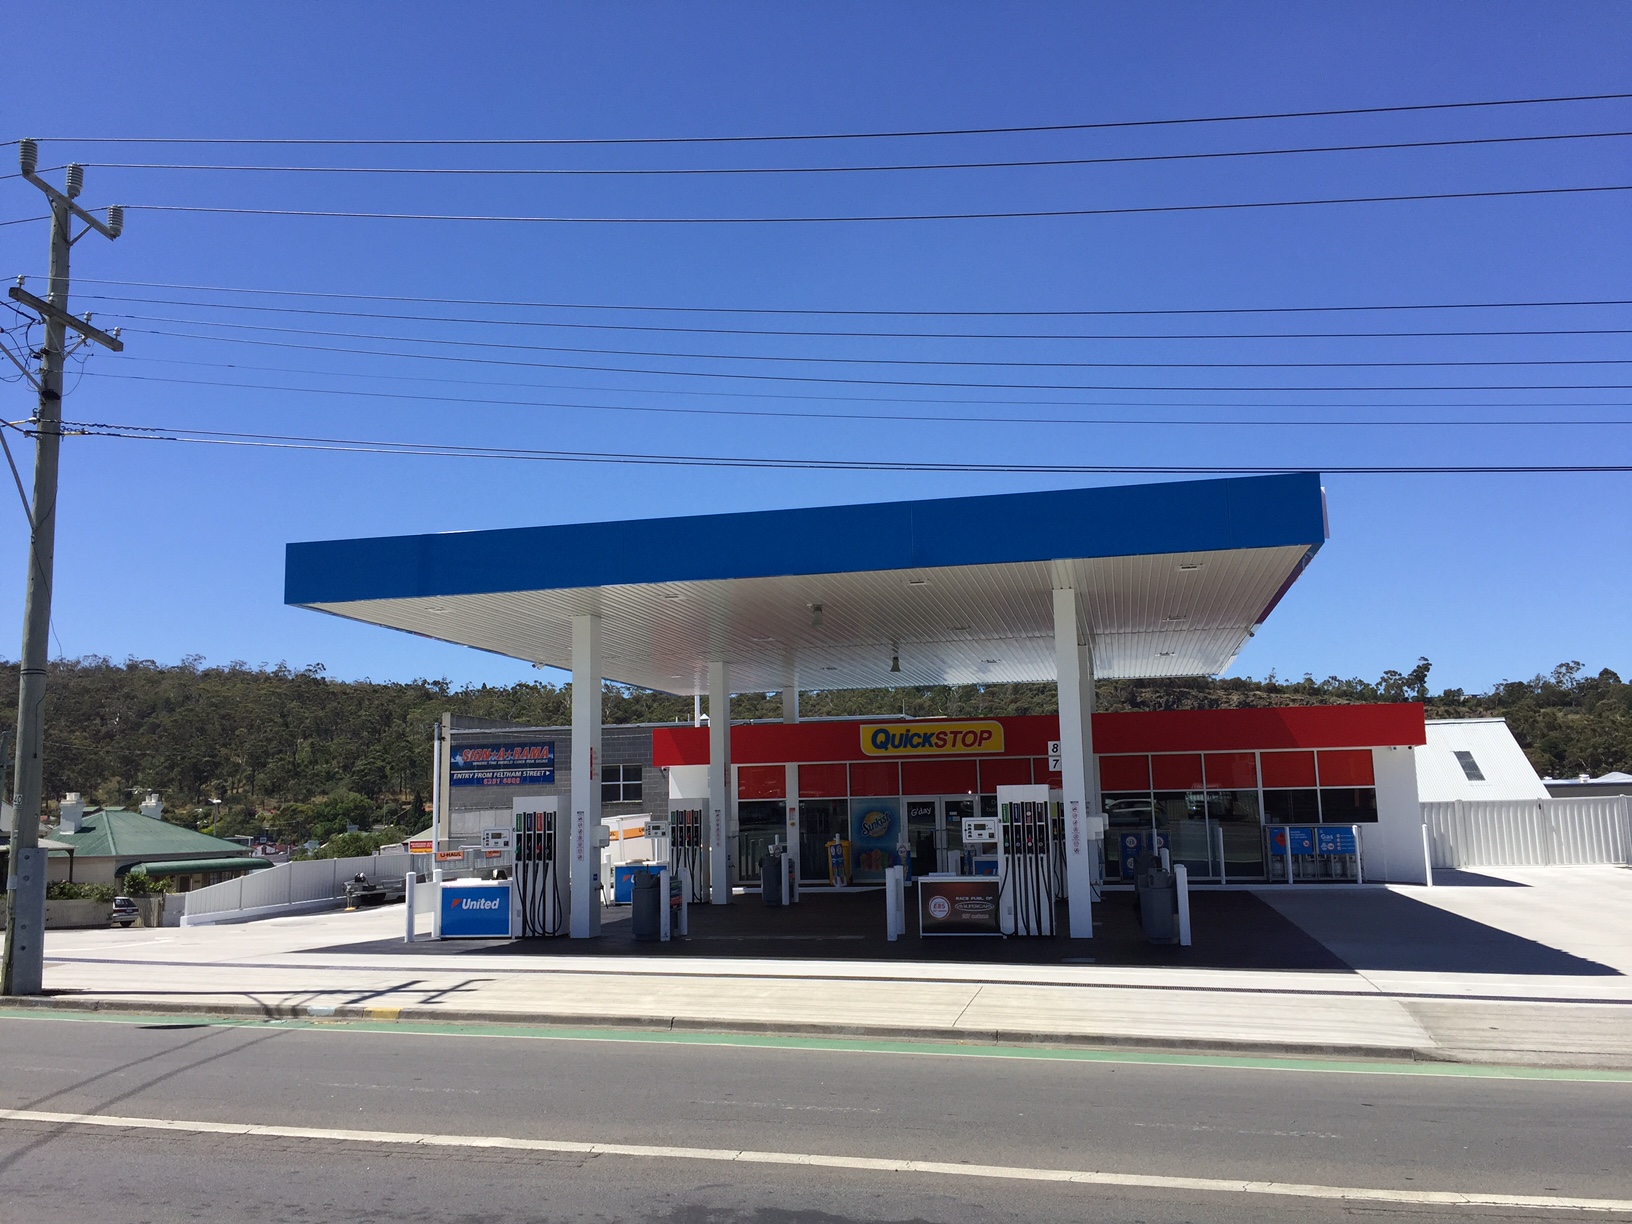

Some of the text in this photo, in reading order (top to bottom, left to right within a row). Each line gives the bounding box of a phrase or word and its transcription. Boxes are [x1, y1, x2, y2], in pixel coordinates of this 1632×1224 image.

[1051, 743, 1059, 753] 8
[1052, 759, 1060, 769] 7
[910, 807, 932, 817] G'day
[861, 811, 891, 837] Sunkist
[461, 898, 500, 910] United
